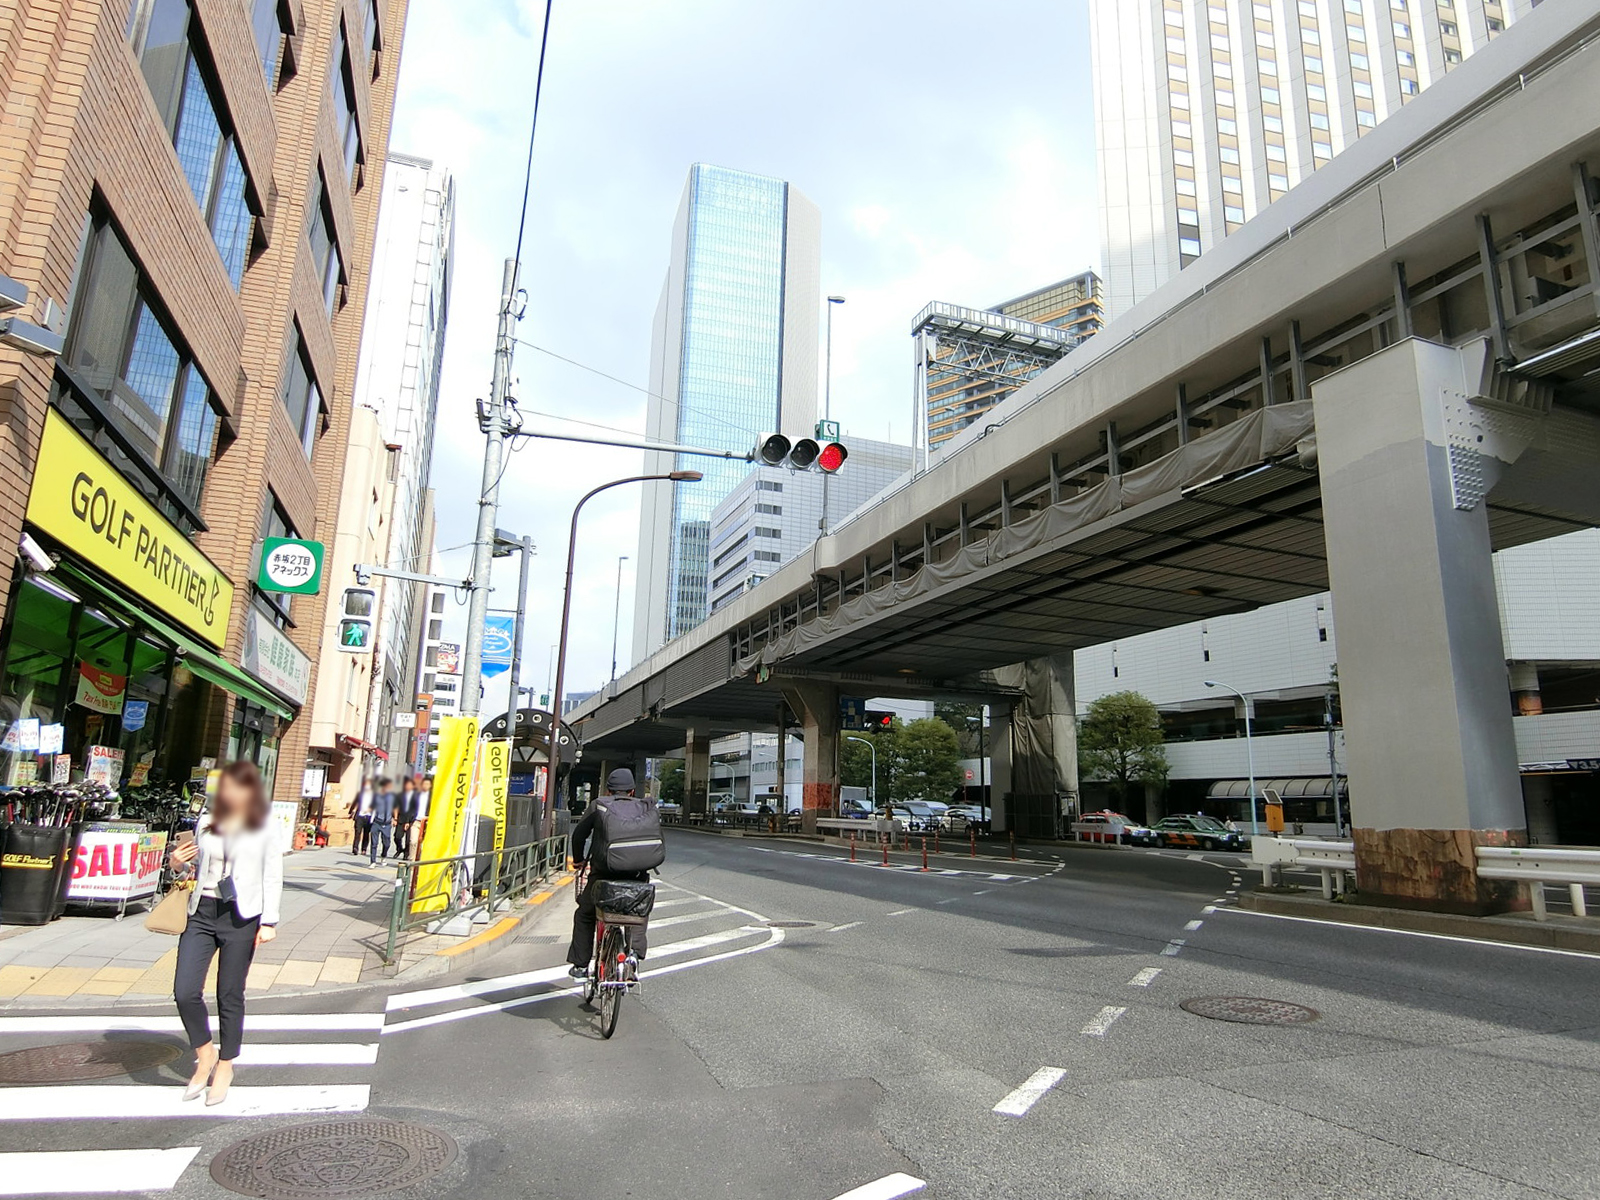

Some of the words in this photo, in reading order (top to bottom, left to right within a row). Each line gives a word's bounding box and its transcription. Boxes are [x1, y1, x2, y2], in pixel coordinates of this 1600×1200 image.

[72, 472, 134, 549] GOLF
[272, 564, 309, 577] アネックス
[3, 854, 23, 862] GOLF
